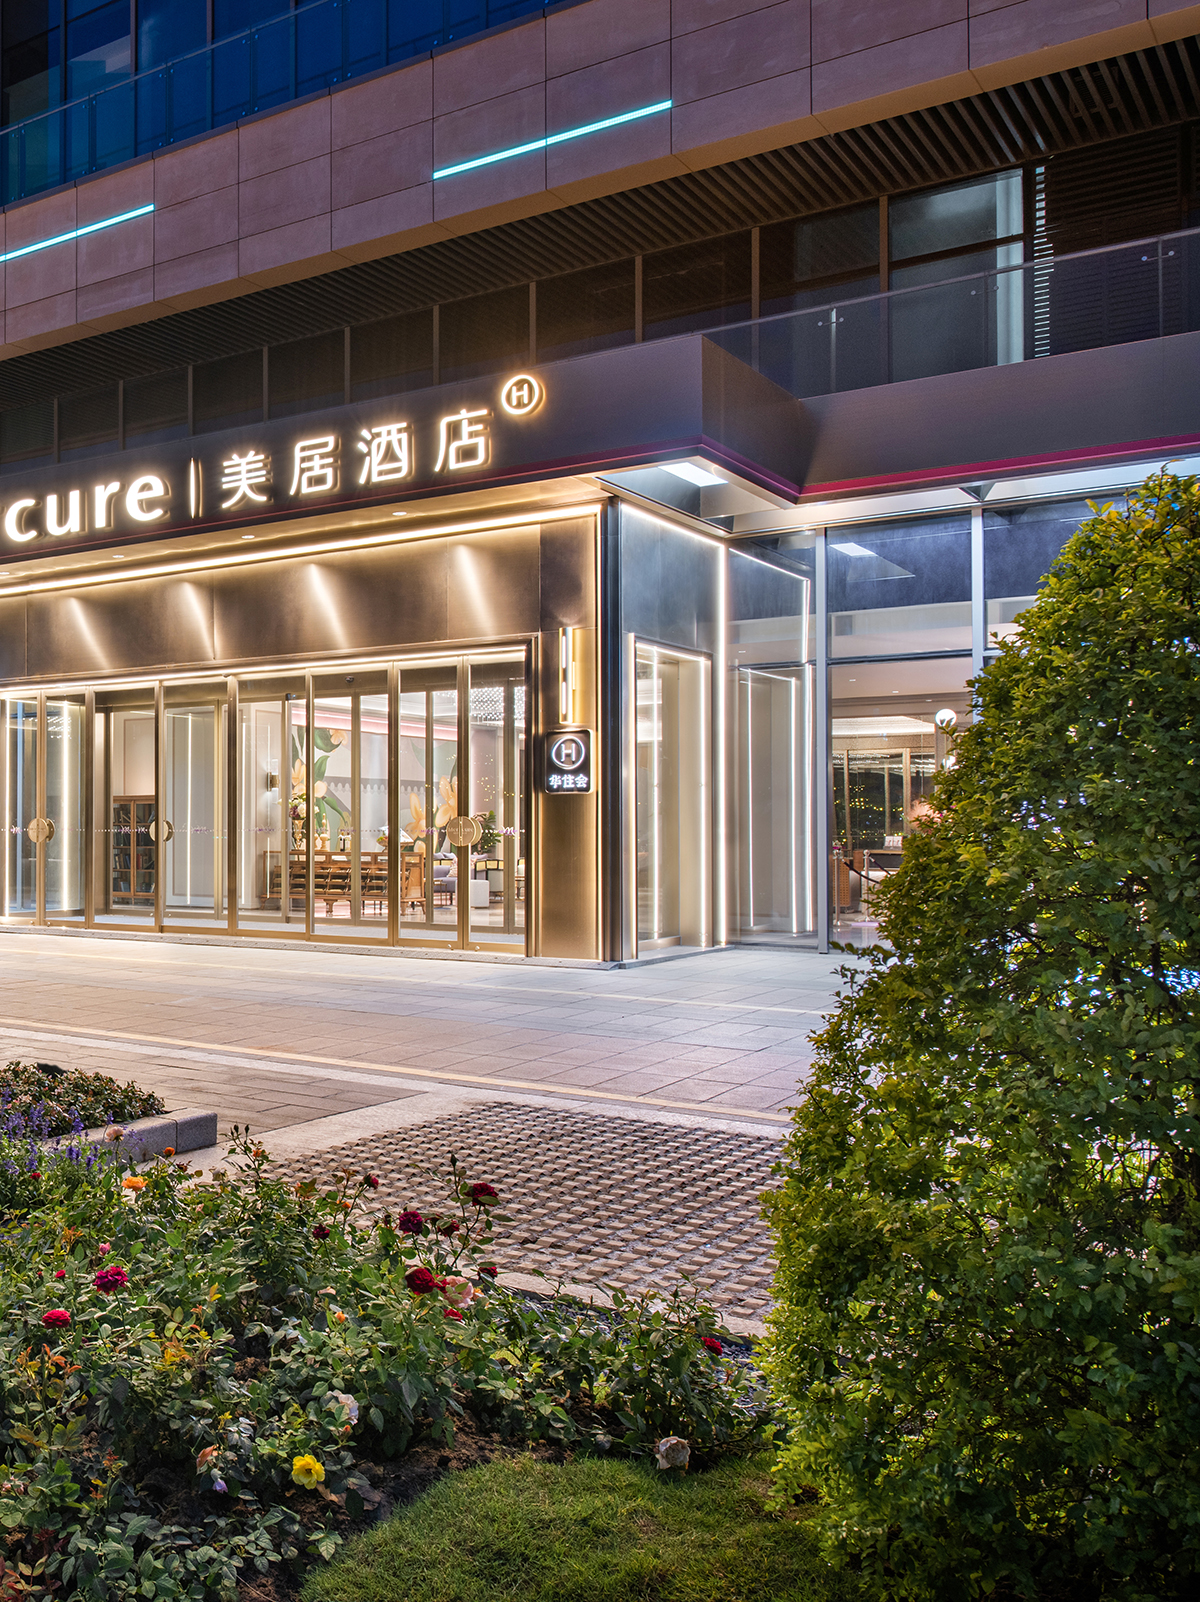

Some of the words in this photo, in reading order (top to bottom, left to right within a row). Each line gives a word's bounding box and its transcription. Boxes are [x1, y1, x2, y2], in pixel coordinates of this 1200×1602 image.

[221, 409, 490, 509] 美居酒店
[548, 773, 588, 789] 华住会
